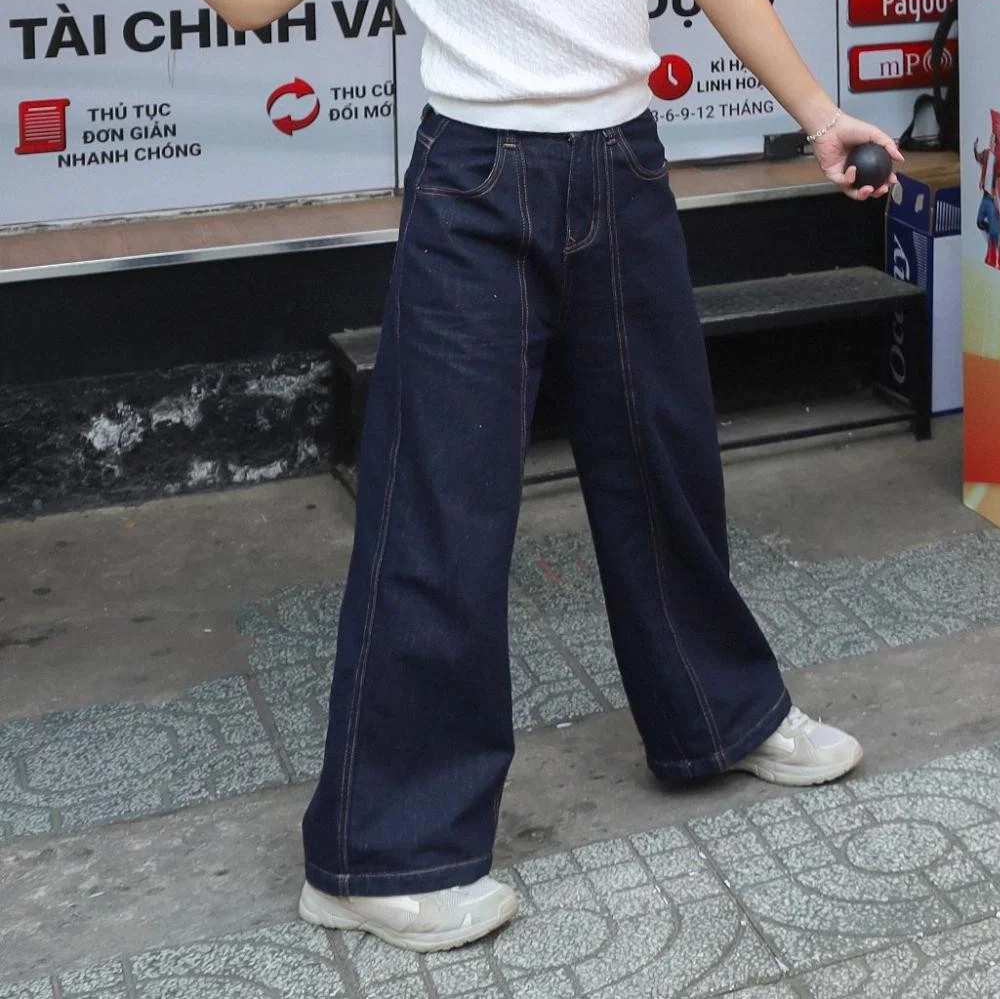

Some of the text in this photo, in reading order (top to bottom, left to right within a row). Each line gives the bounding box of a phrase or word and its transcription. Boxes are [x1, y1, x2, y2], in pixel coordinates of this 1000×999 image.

[9, 3, 107, 60] TÀI
[711, 57, 725, 73] KÌ
[330, 85, 366, 101] THU
[697, 79, 732, 93] LINH
[87, 102, 172, 124] THỦ TỤC
[718, 99, 774, 118] THÁNG
[82, 121, 178, 146] ĐƠN GIẢN
[57, 142, 202, 169] NHANH CHÓNG
